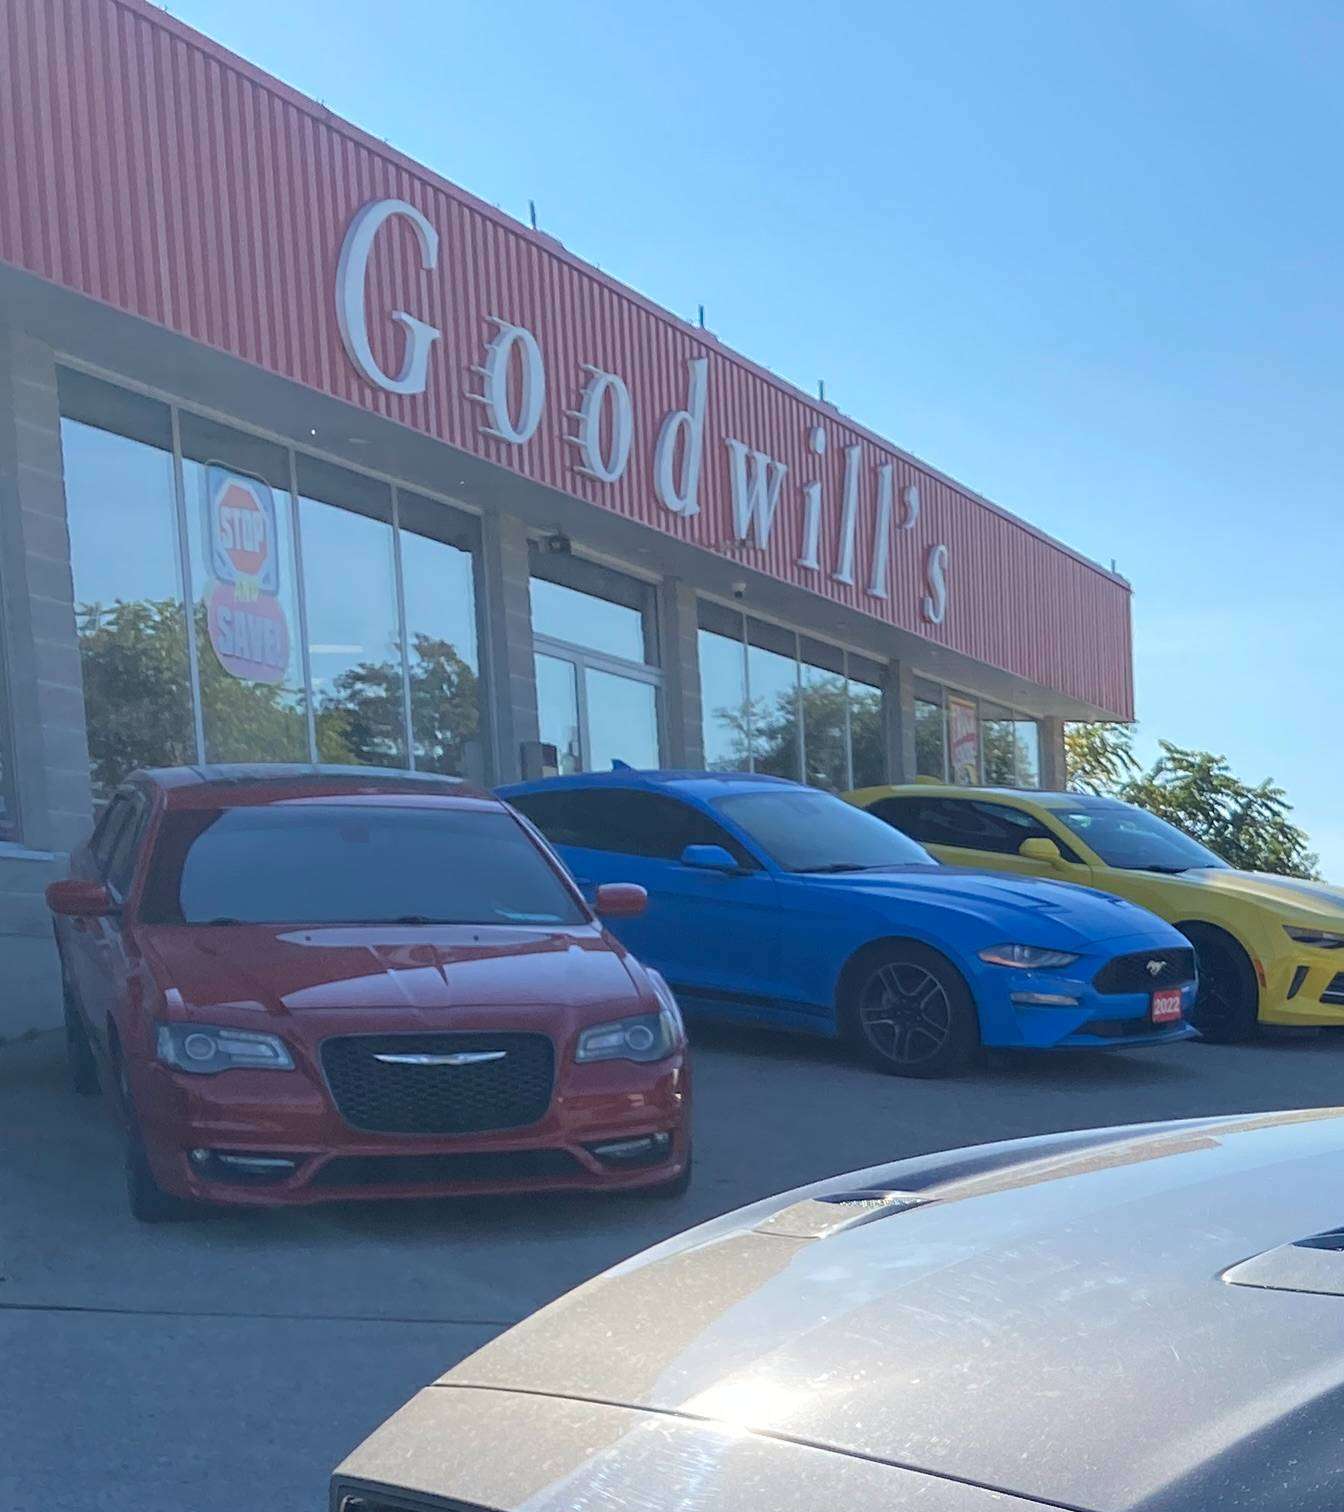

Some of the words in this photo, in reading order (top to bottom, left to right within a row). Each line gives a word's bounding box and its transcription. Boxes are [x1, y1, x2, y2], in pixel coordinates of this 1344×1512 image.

[336, 198, 949, 624] Goodwill's
[219, 506, 267, 553] STOP
[1153, 996, 1180, 1015] 2022
